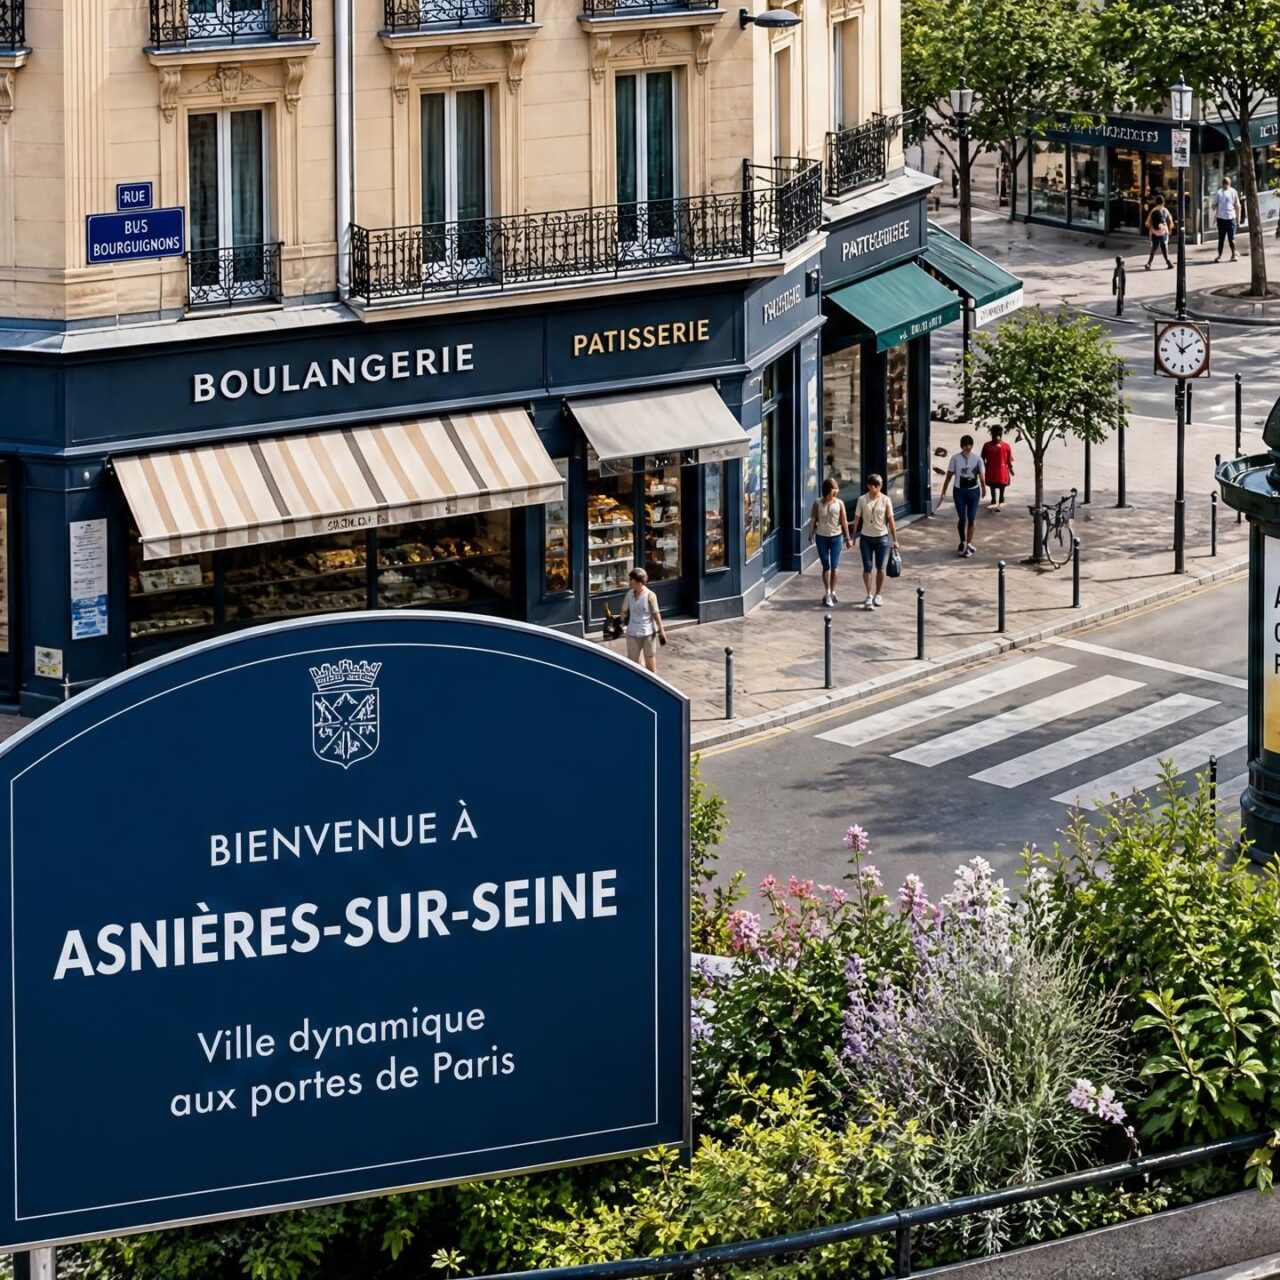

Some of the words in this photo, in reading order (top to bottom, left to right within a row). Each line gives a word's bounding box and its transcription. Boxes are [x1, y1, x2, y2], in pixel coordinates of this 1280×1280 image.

[123, 190, 146, 204] RUE
[93, 236, 180, 257] BOURGUIGNONS
[573, 319, 711, 357] PATISSERIE
[193, 343, 476, 404] BOULANGERIE
[210, 812, 437, 867] BIENVENUE
[451, 799, 478, 841] À
[53, 868, 618, 980] ASNIÈRES-SUR-SEINE
[197, 1023, 276, 1063] Ville
[289, 1006, 486, 1059] dynamique
[170, 1088, 237, 1117] aux
[250, 1068, 363, 1118] portes
[376, 1055, 419, 1091] de
[433, 1046, 515, 1084] Paris
